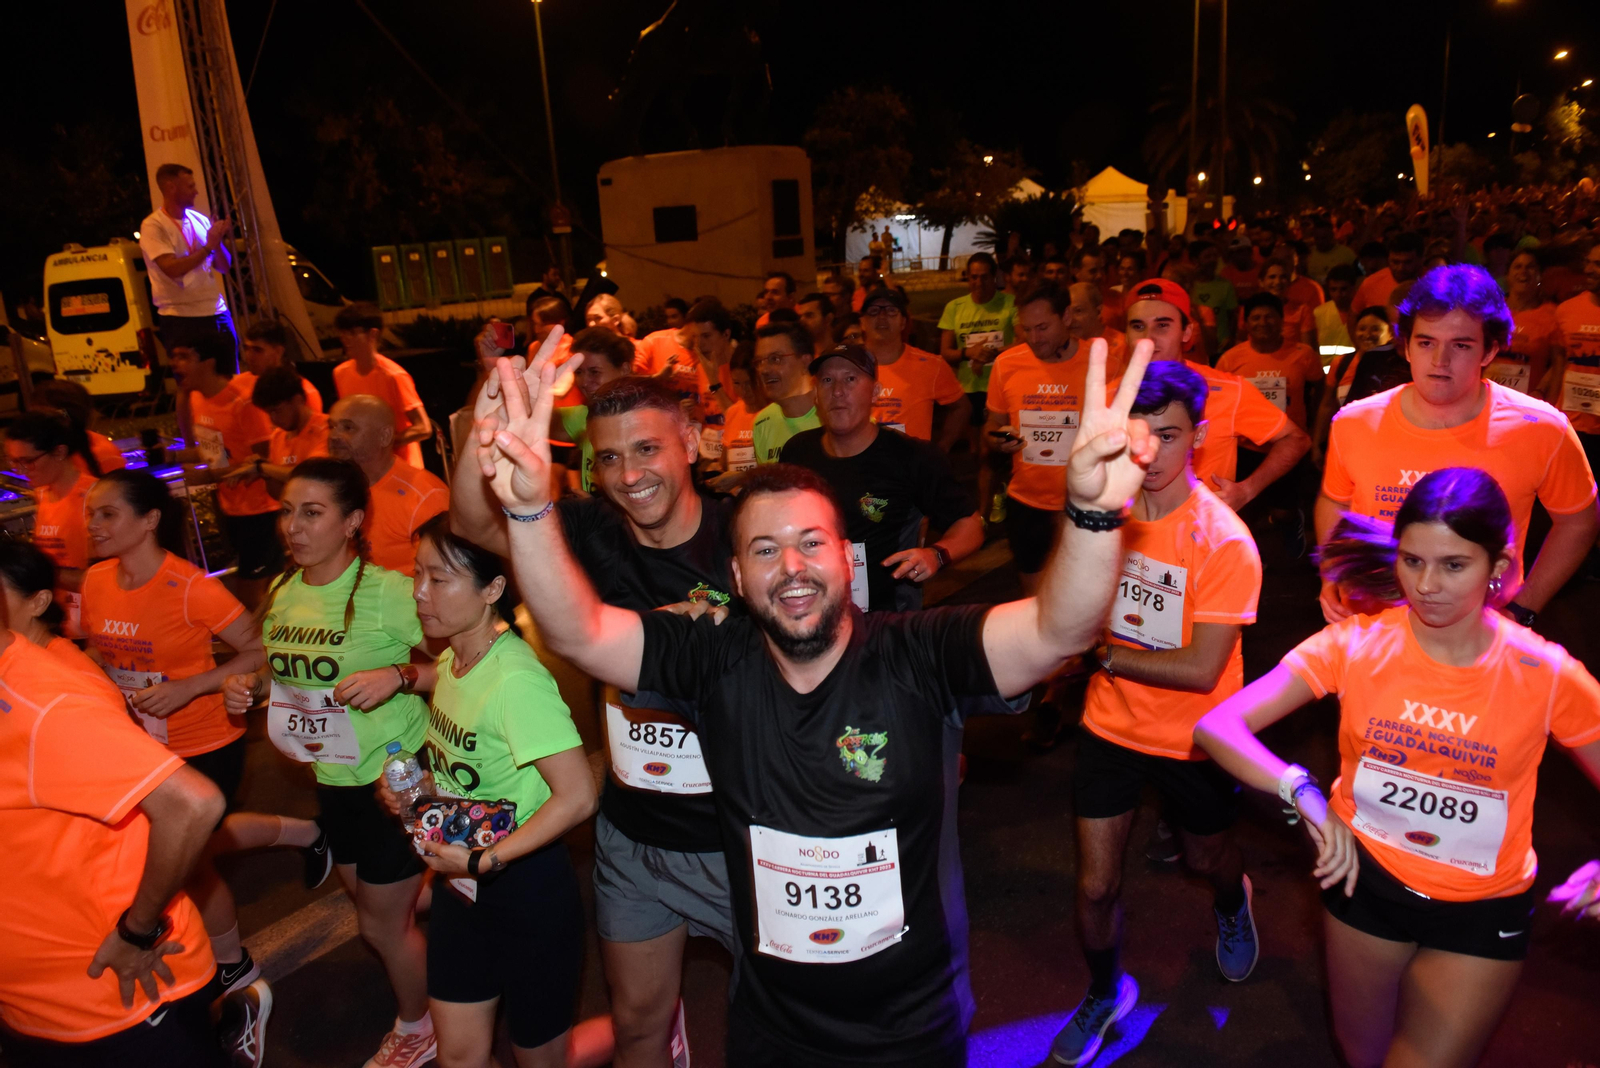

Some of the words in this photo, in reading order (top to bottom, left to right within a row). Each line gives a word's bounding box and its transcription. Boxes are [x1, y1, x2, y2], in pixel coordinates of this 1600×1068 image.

[53, 254, 108, 266] AMBULANCIA
[1037, 383, 1069, 394] XXXV
[1033, 430, 1063, 442] 5527
[1398, 469, 1433, 486] XX
[1120, 580, 1165, 612] 1978
[102, 619, 139, 637] XXXV
[287, 713, 328, 735] 5137
[1398, 698, 1479, 736] XXXV
[628, 721, 690, 750] 8857
[1364, 726, 1373, 739] DEL
[1368, 716, 1423, 737] CARRERA
[1428, 730, 1499, 756] NOCTURNA
[640, 748, 676, 759] VILLALPANDO
[1373, 729, 1497, 769] GUADALQUIVIR
[1379, 781, 1478, 824] 22089
[785, 881, 862, 910] 9138
[775, 908, 808, 921] LEONARDO
[808, 914, 843, 922] GONZÁLEZ
[844, 909, 879, 921] ARELLANO
